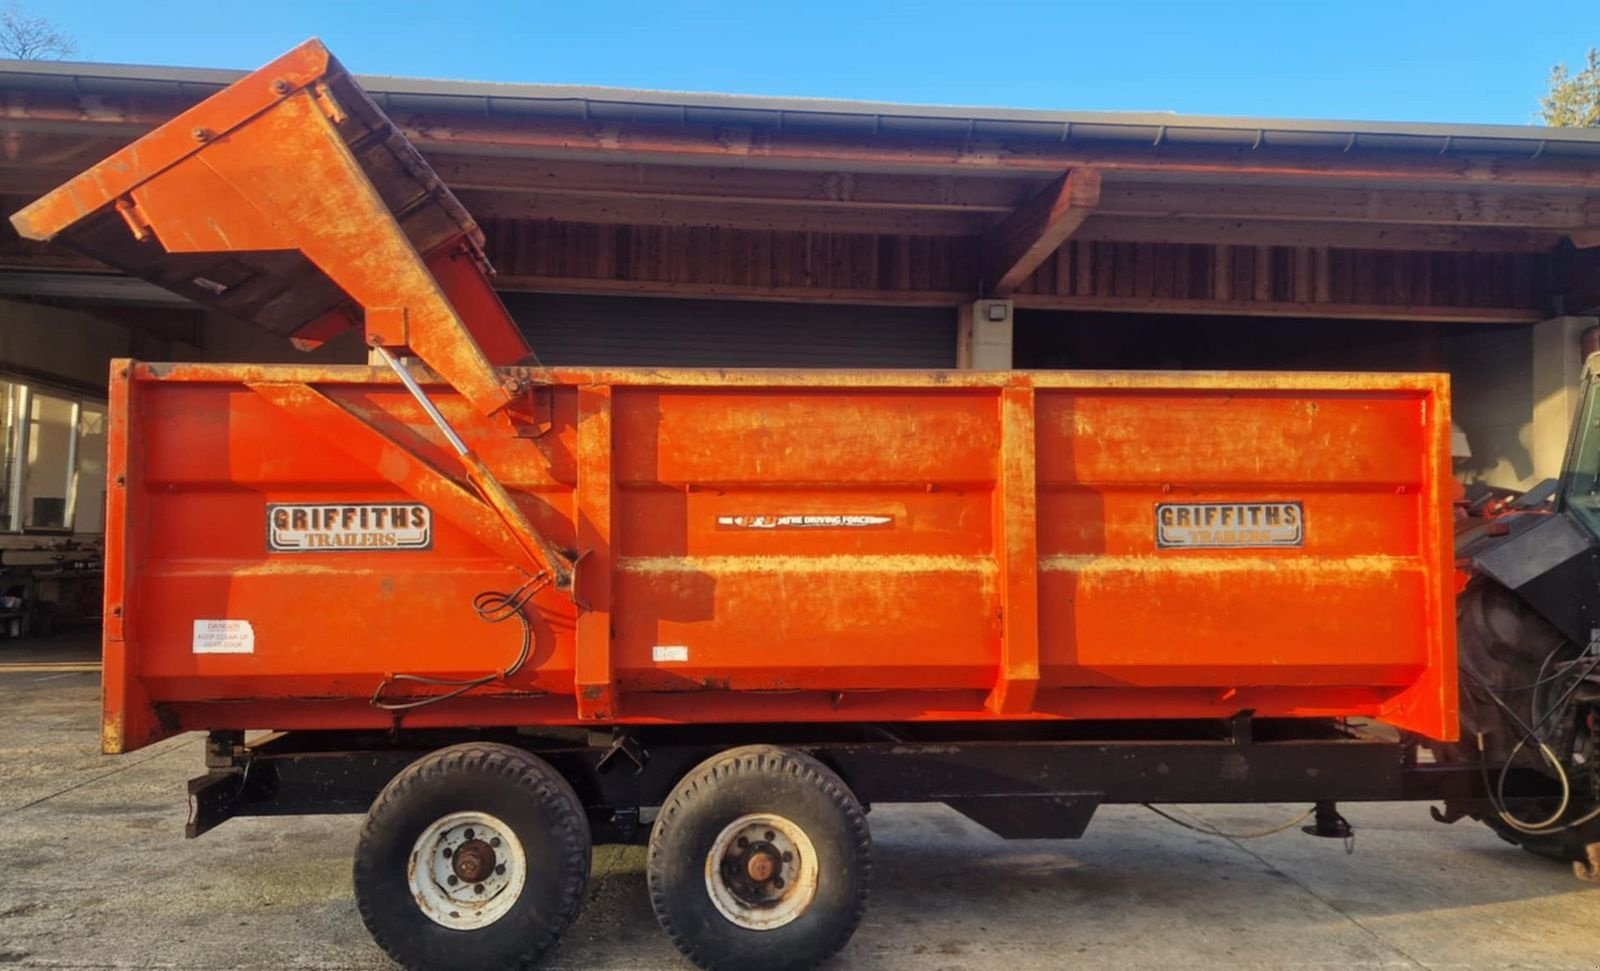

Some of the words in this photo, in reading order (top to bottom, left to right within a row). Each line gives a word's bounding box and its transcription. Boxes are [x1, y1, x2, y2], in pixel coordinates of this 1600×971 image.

[273, 506, 426, 530] GRIFFITHS
[1160, 506, 1297, 527] GRIFFITHS
[304, 533, 397, 547] TRAILERS
[1188, 530, 1272, 544] TRAILERS
